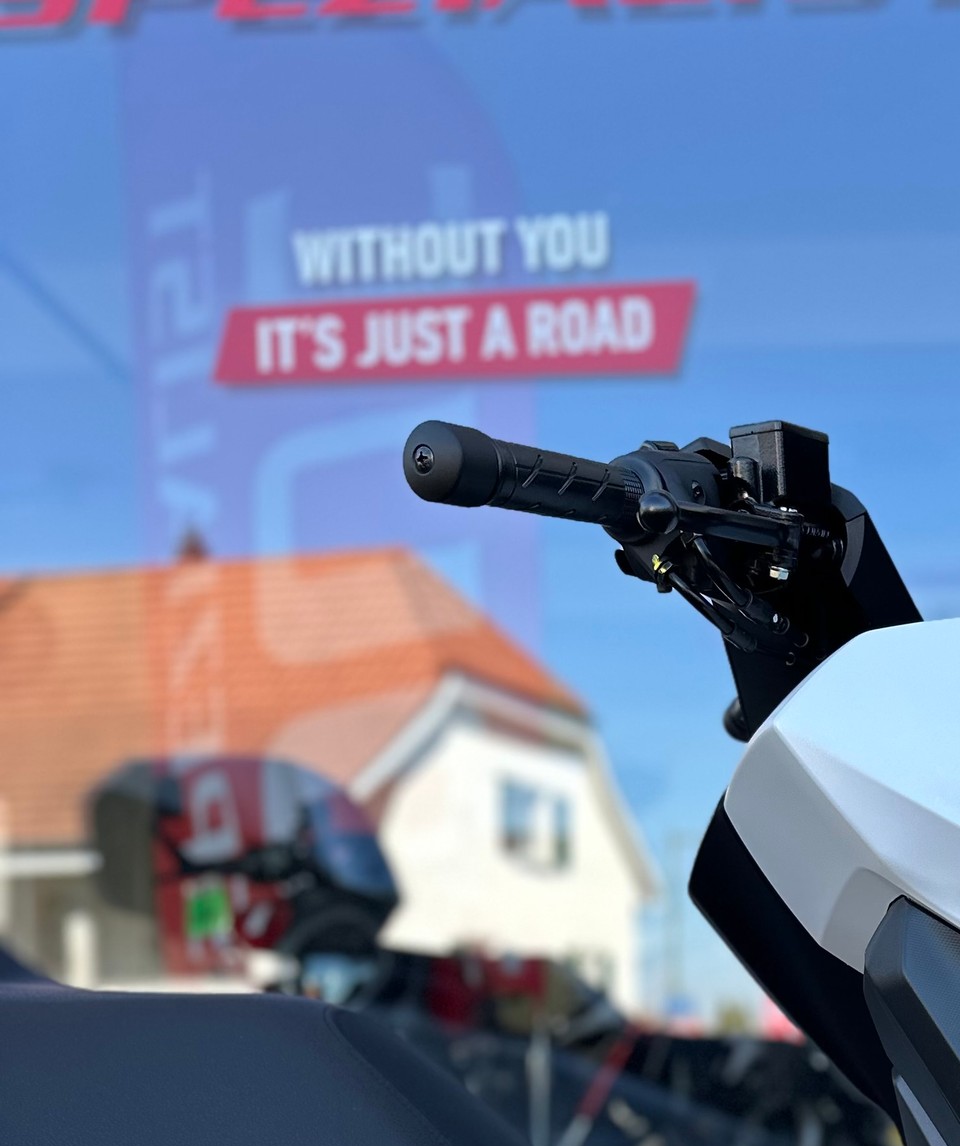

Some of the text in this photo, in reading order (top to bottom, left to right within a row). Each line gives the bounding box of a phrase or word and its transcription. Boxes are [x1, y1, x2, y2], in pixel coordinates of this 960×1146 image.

[292, 211, 610, 286] WITHOUT YOU
[254, 296, 654, 374] IT'S JUST A ROAD
